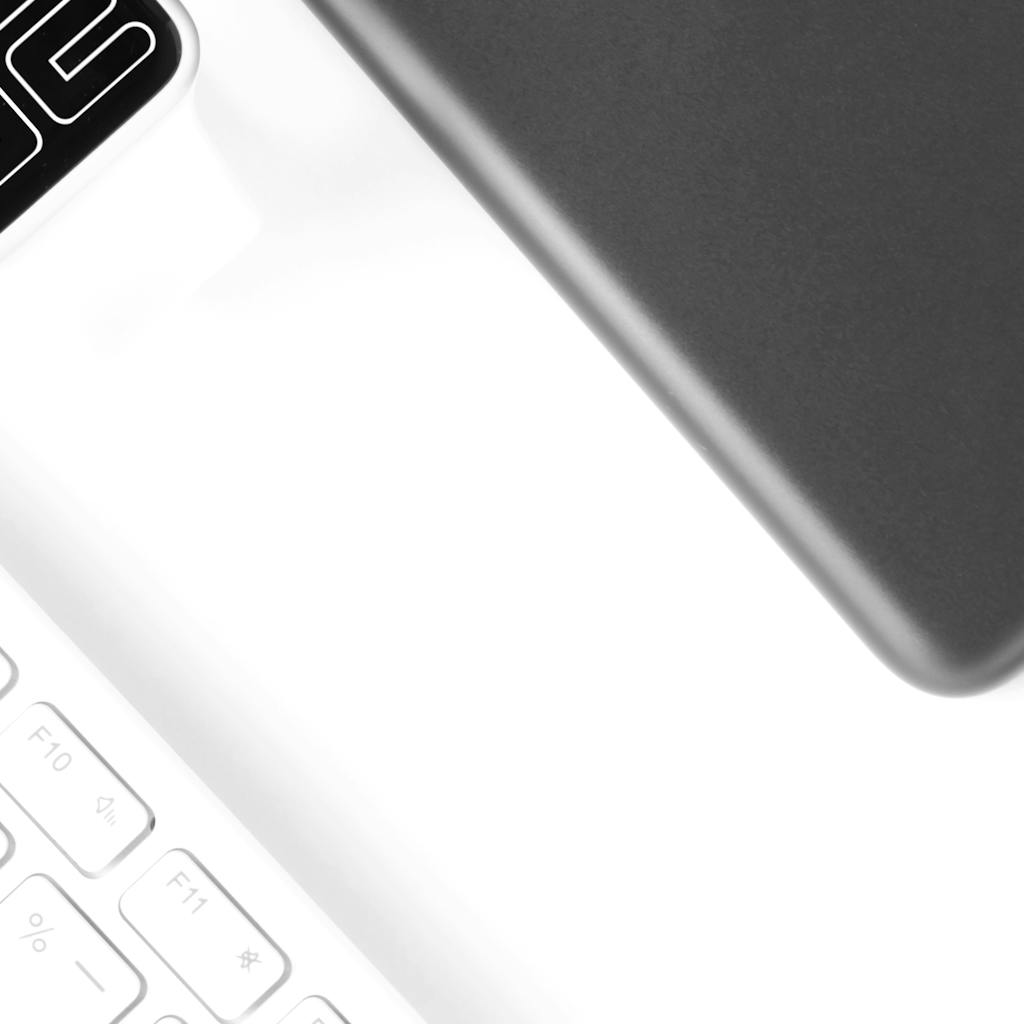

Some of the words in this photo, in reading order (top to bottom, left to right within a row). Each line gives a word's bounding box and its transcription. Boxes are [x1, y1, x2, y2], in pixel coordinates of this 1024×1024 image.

[27, 724, 73, 772] F10
[165, 869, 209, 915] F11
[18, 912, 55, 953] %
